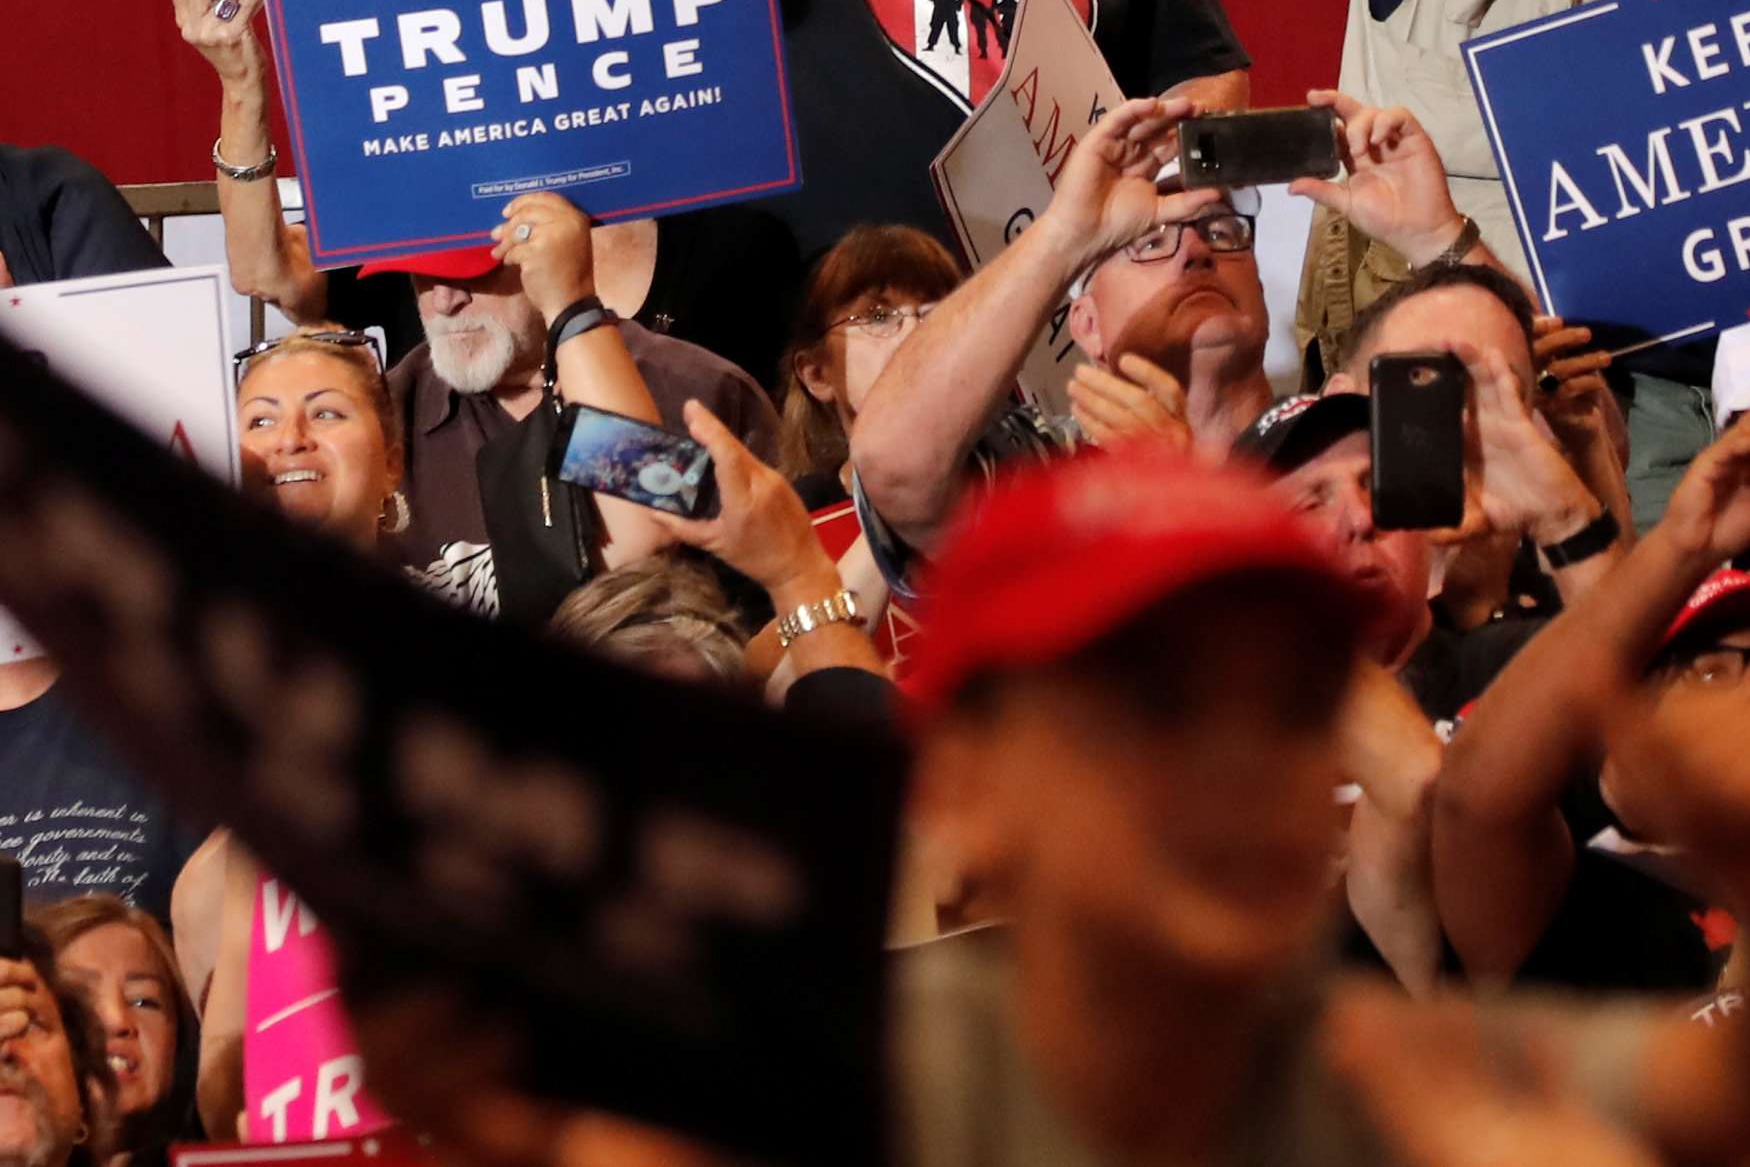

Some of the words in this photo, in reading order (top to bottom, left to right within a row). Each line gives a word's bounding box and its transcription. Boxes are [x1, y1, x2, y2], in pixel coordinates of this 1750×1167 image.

[370, 38, 703, 123] PENCE
[363, 133, 430, 157] MAKE
[438, 118, 547, 148] AMERICA
[554, 103, 631, 131] GREAT
[639, 86, 723, 117] AGAIN!
[50, 799, 128, 820] inherent
[24, 827, 147, 856] governments
